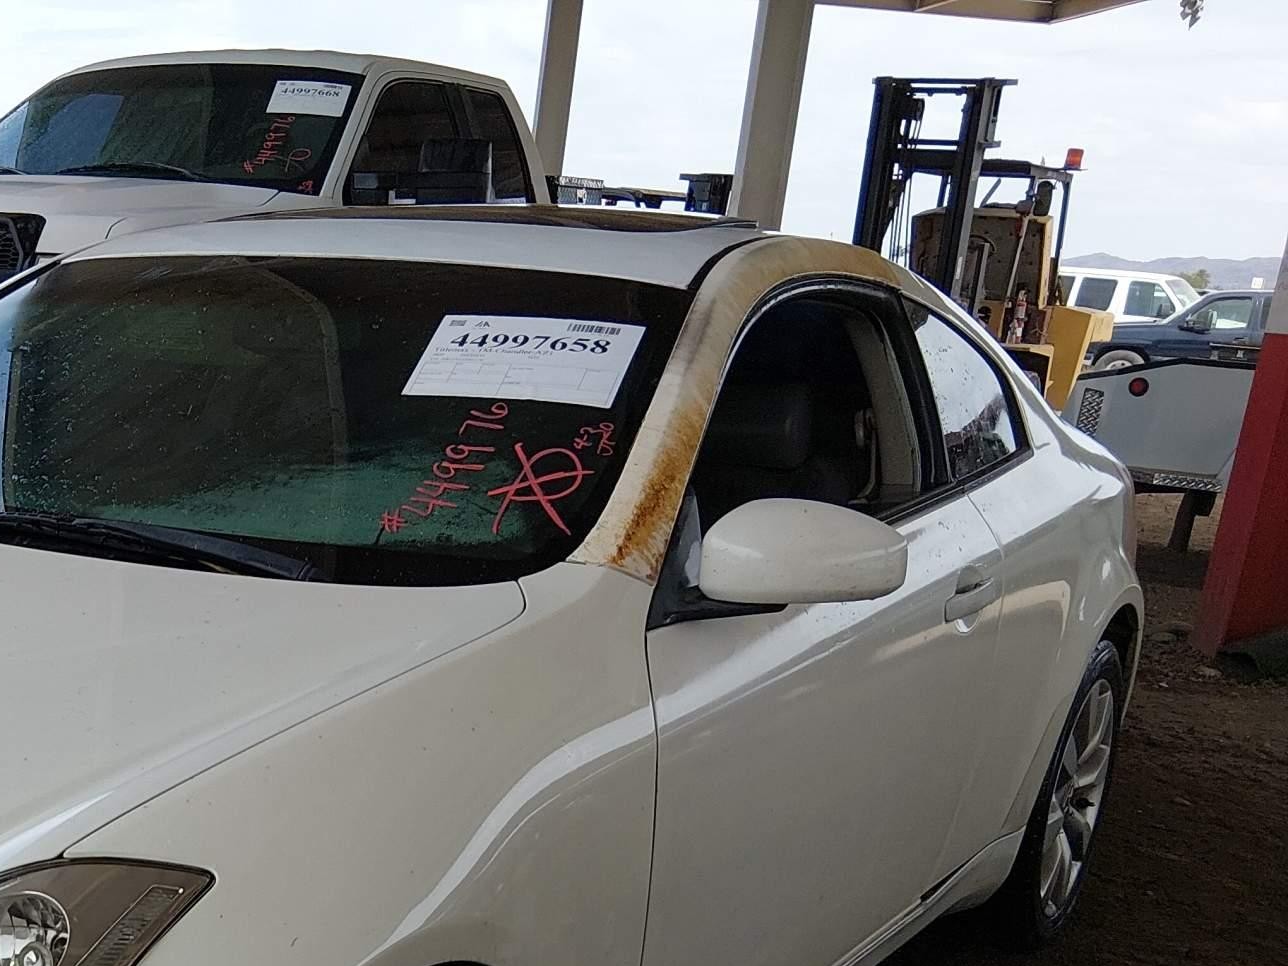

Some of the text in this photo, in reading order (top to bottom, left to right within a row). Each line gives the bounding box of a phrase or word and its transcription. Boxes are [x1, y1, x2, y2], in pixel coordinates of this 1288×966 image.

[281, 87, 340, 97] 44997668
[450, 332, 611, 354] 44997658
[380, 402, 508, 534] #449976
